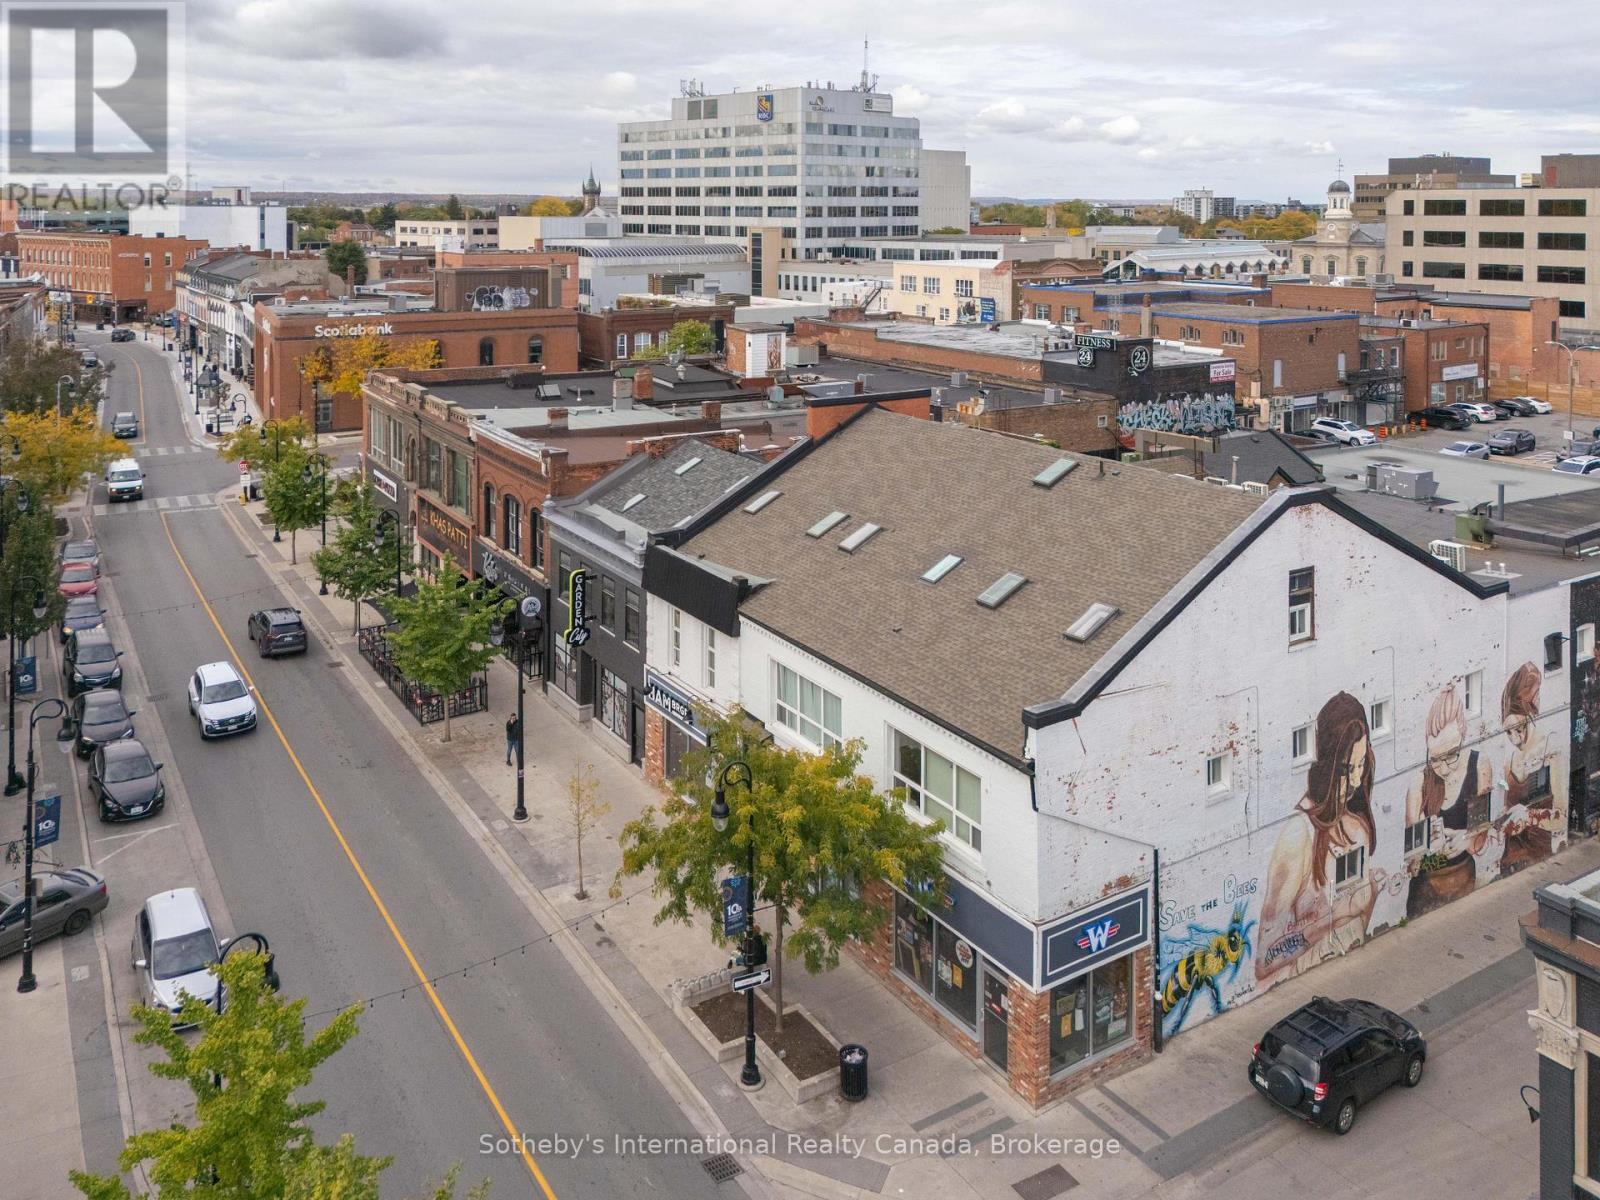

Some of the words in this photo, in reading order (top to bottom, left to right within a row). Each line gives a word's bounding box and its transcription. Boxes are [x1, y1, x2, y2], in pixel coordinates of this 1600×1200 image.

[314, 322, 393, 337] Scotiabank
[1077, 336, 1111, 348] FITNESS
[1079, 351, 1091, 361] 24
[1134, 351, 1146, 363] 24
[575, 574, 583, 626] GARDEN
[1201, 898, 1218, 912] THE
[1086, 919, 1112, 952] W
